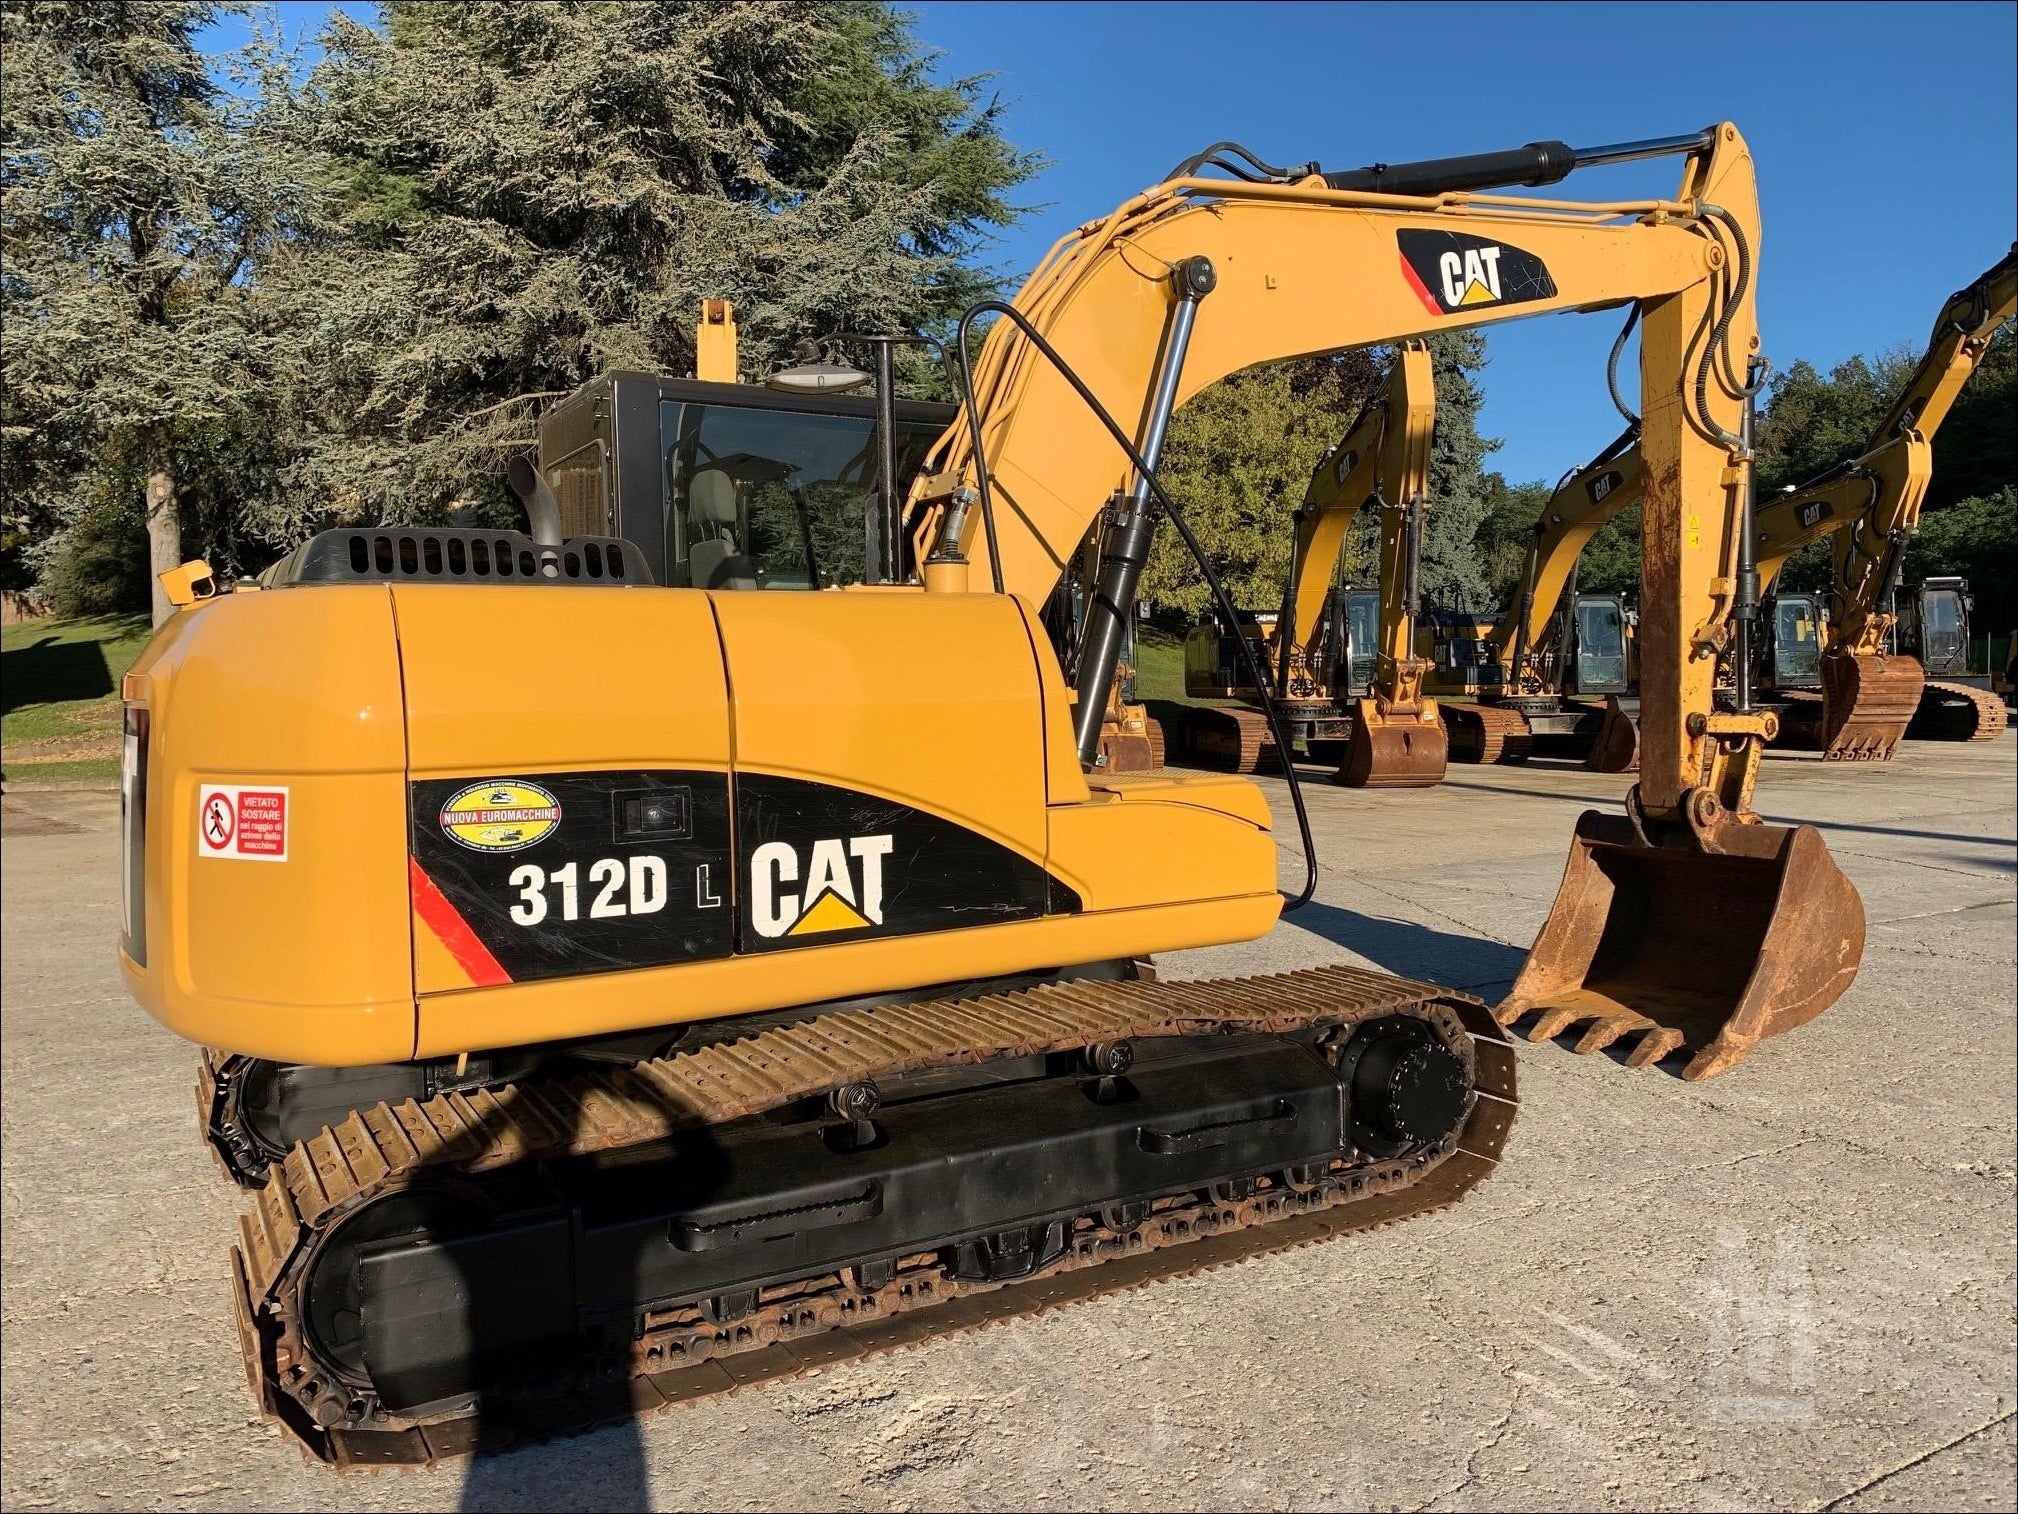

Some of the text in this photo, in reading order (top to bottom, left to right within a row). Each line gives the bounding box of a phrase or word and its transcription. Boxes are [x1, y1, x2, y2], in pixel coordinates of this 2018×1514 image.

[1440, 246, 1502, 307] CAT
[1594, 474, 1611, 501] CAT
[1803, 502, 1820, 527] CAT
[241, 809, 281, 820] SOSTARE
[243, 797, 279, 807] VIETATO
[251, 822, 273, 832] raggio
[274, 823, 282, 831] di
[444, 808, 558, 825] NUOVA EUROMACCHINE
[508, 855, 721, 926] 312D L
[751, 834, 893, 938] CAT
